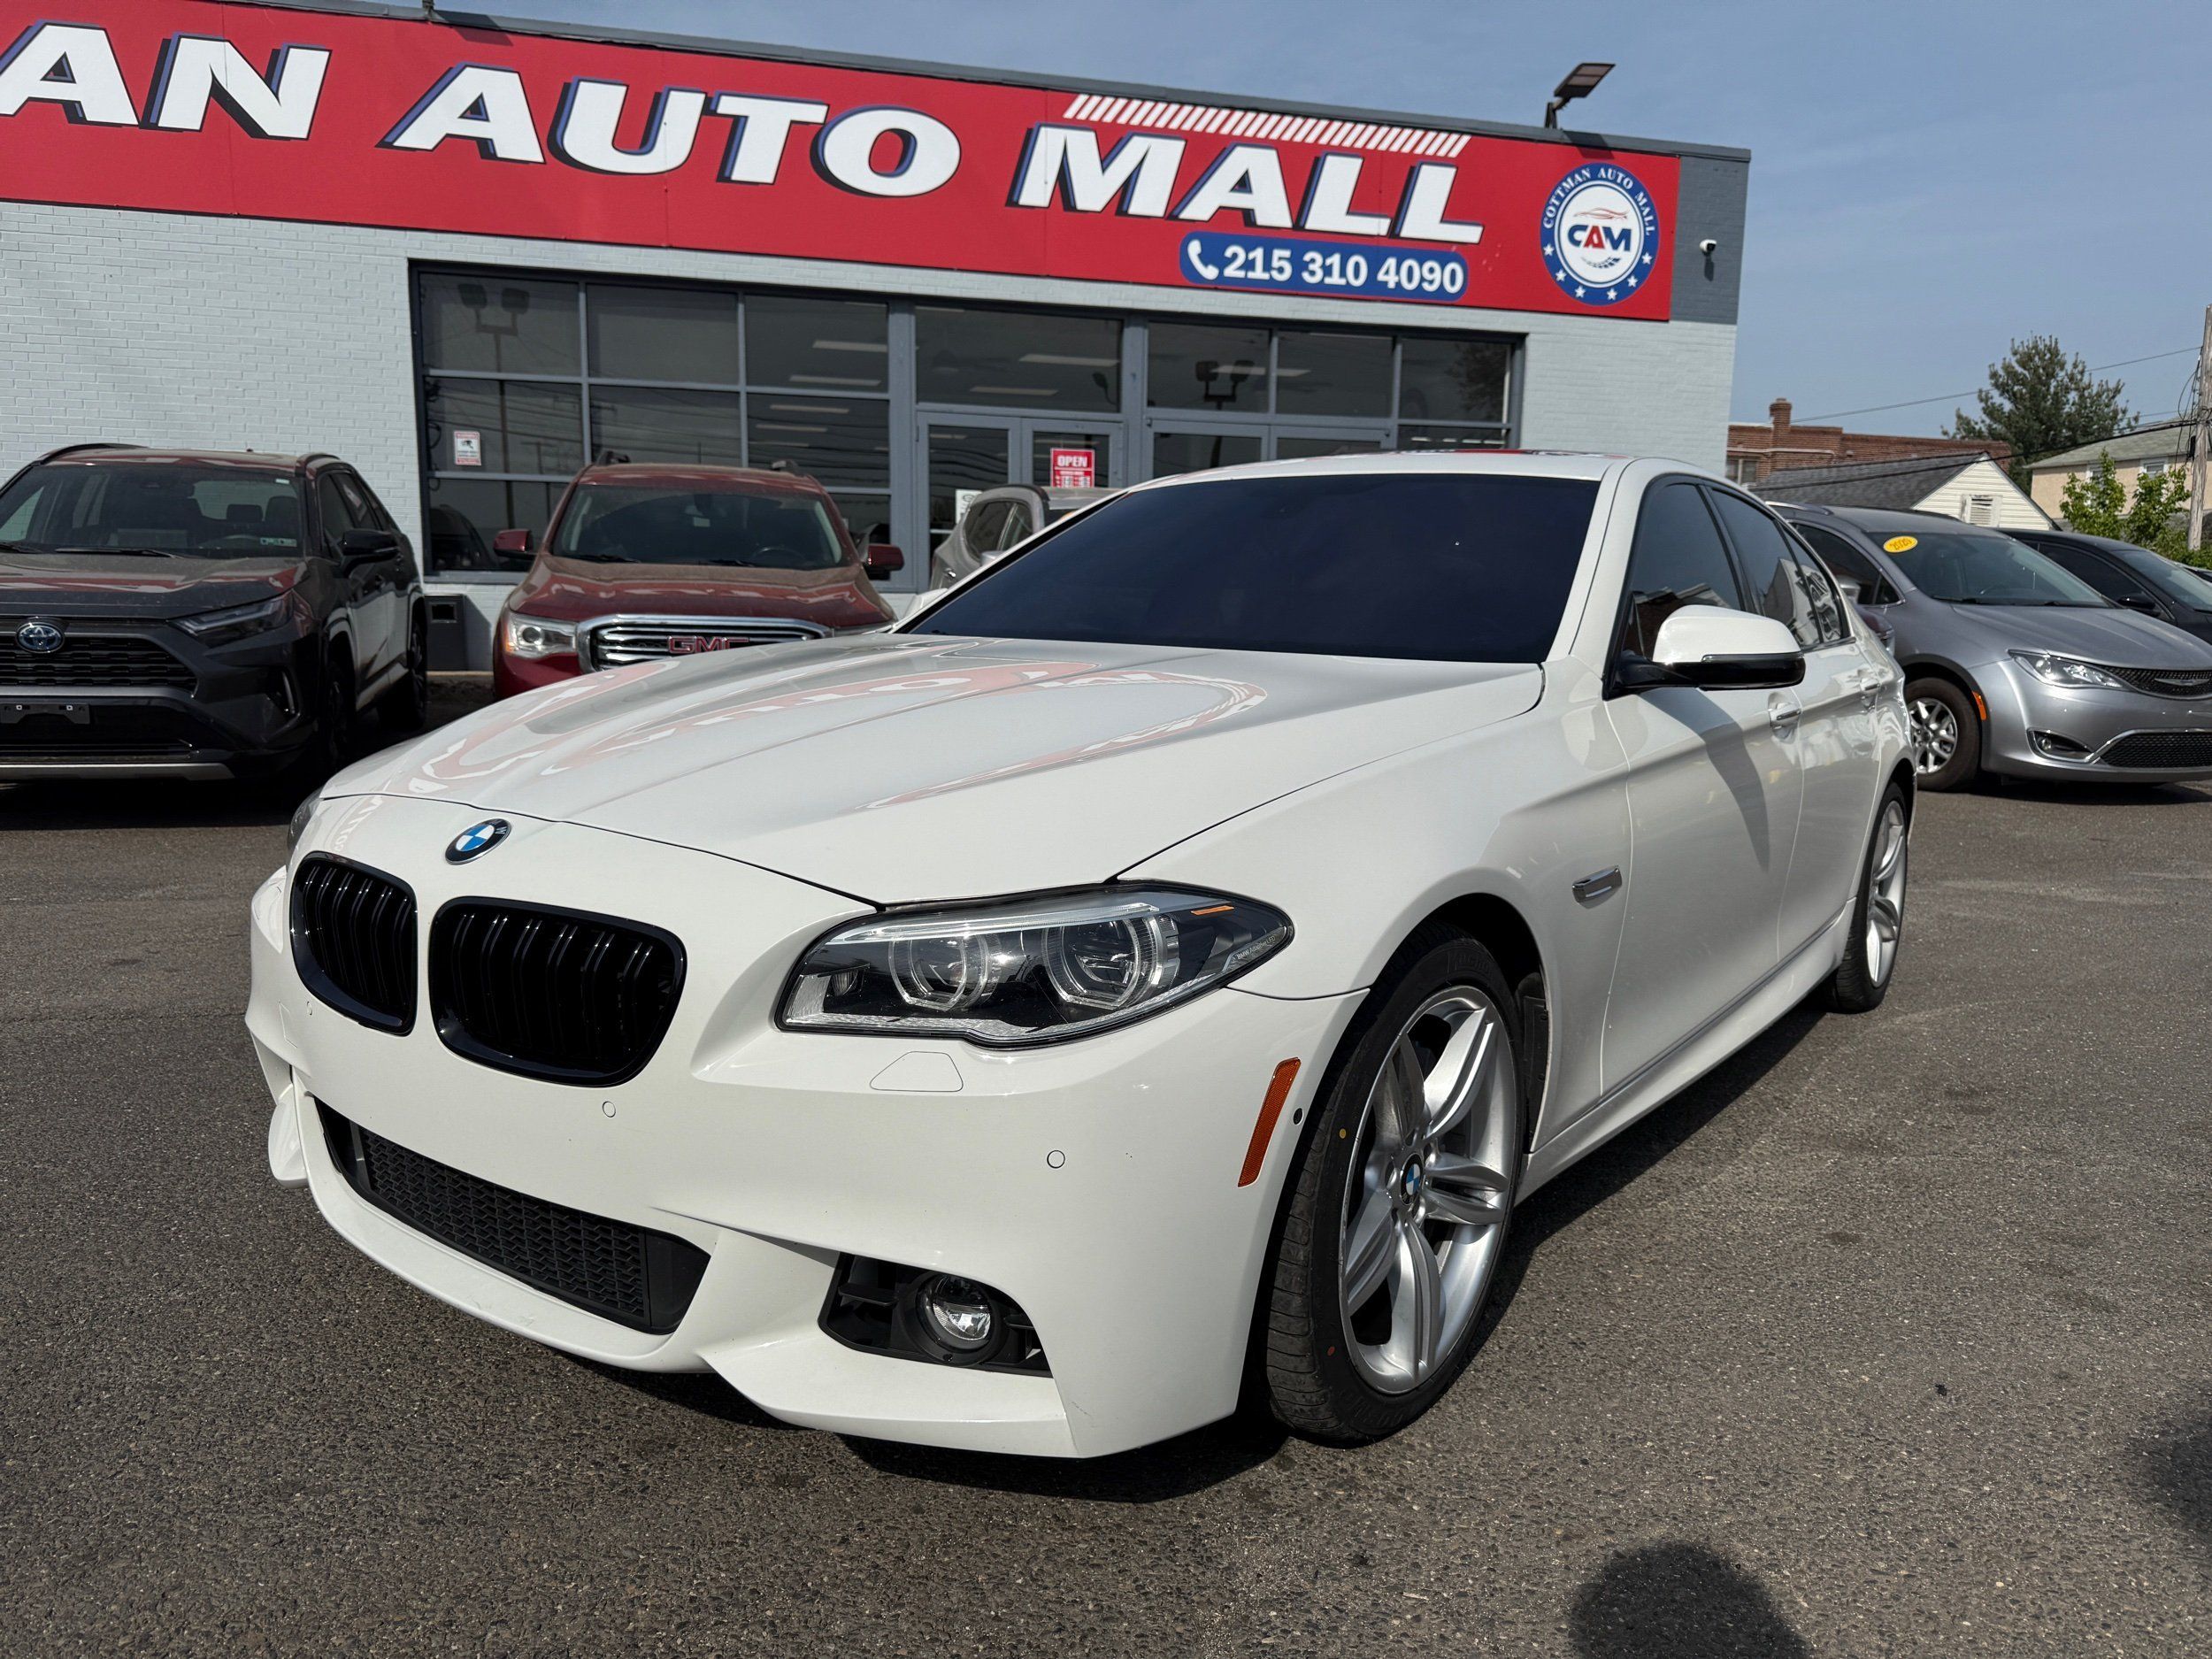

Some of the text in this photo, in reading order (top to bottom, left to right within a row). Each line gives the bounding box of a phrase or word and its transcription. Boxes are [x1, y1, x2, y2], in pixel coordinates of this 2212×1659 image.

[379, 62, 961, 196] AUTO
[1006, 120, 1484, 243] MALL
[1543, 167, 1655, 236] COTTMAN AUTO MALL
[1568, 225, 1632, 251] CAM
[1223, 244, 1463, 294] 215 310 4090
[1057, 455, 1087, 467] OPEN
